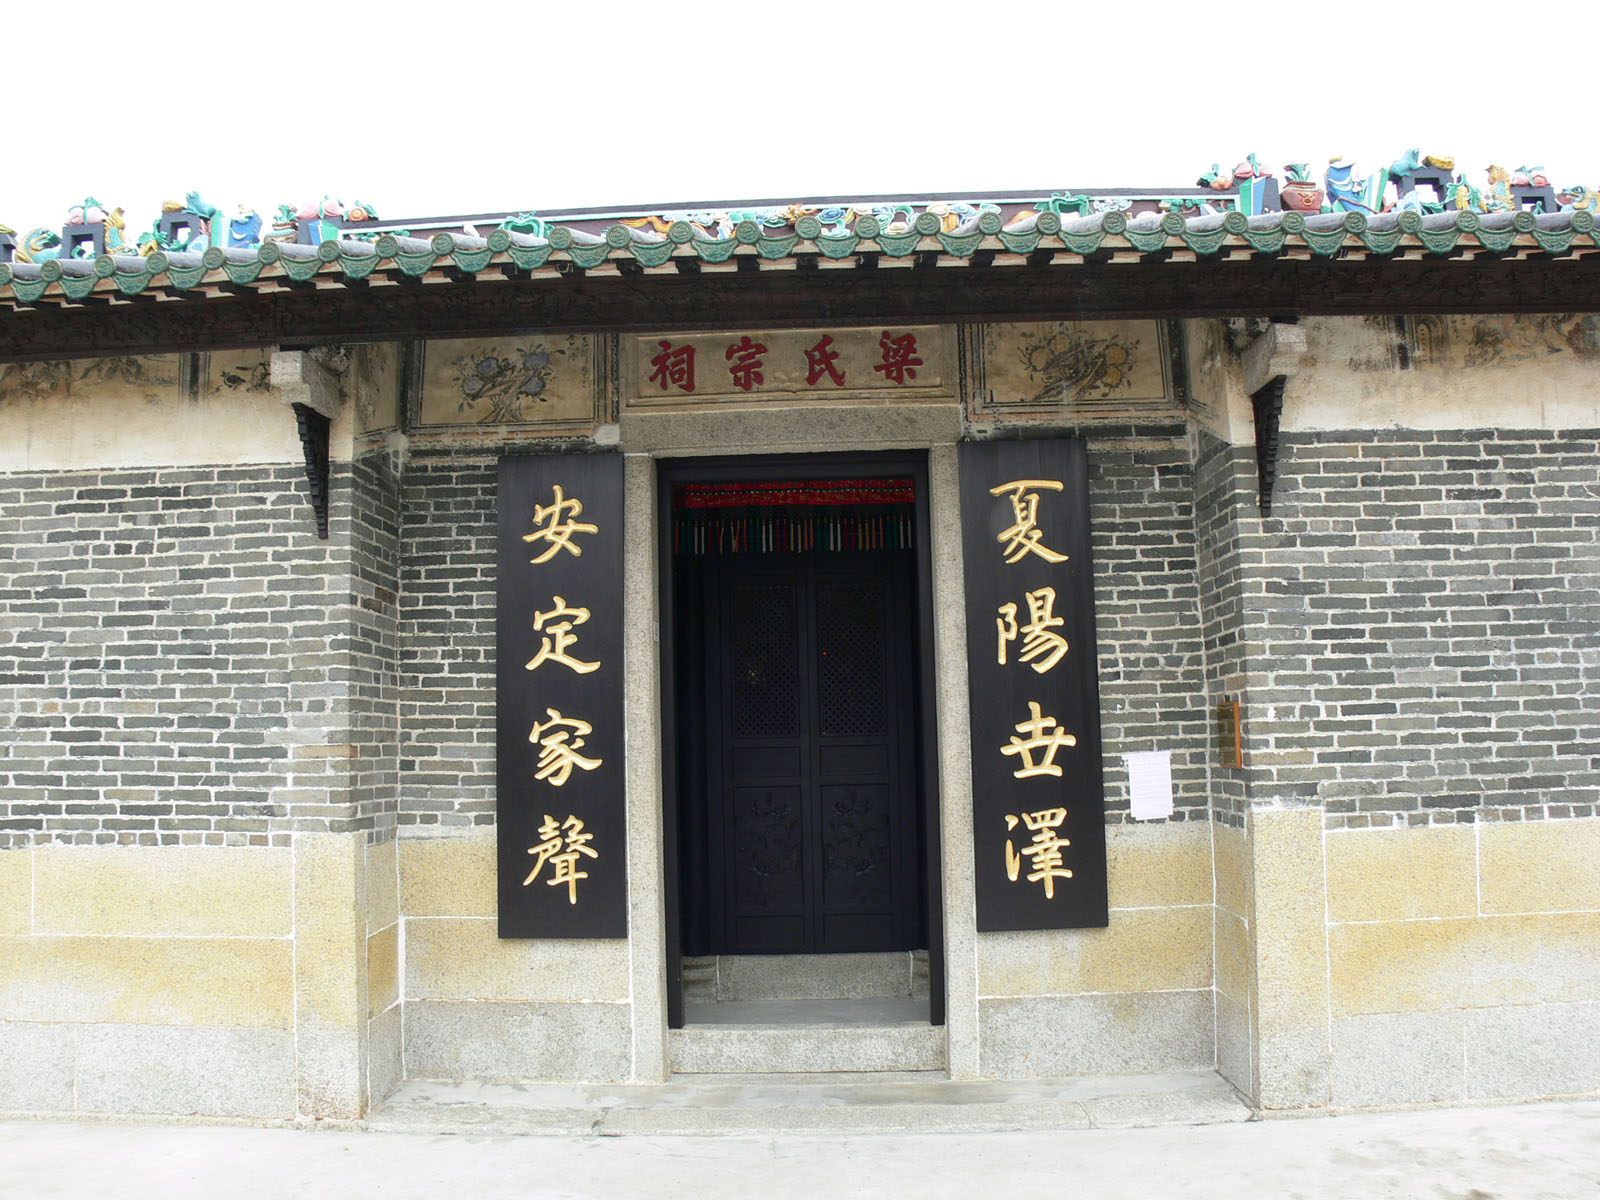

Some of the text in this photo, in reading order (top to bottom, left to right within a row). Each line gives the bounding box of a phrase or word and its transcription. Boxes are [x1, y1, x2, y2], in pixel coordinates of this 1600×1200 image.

[650, 331, 923, 393] 梁氏宗祠
[522, 485, 602, 905] 安定家聲
